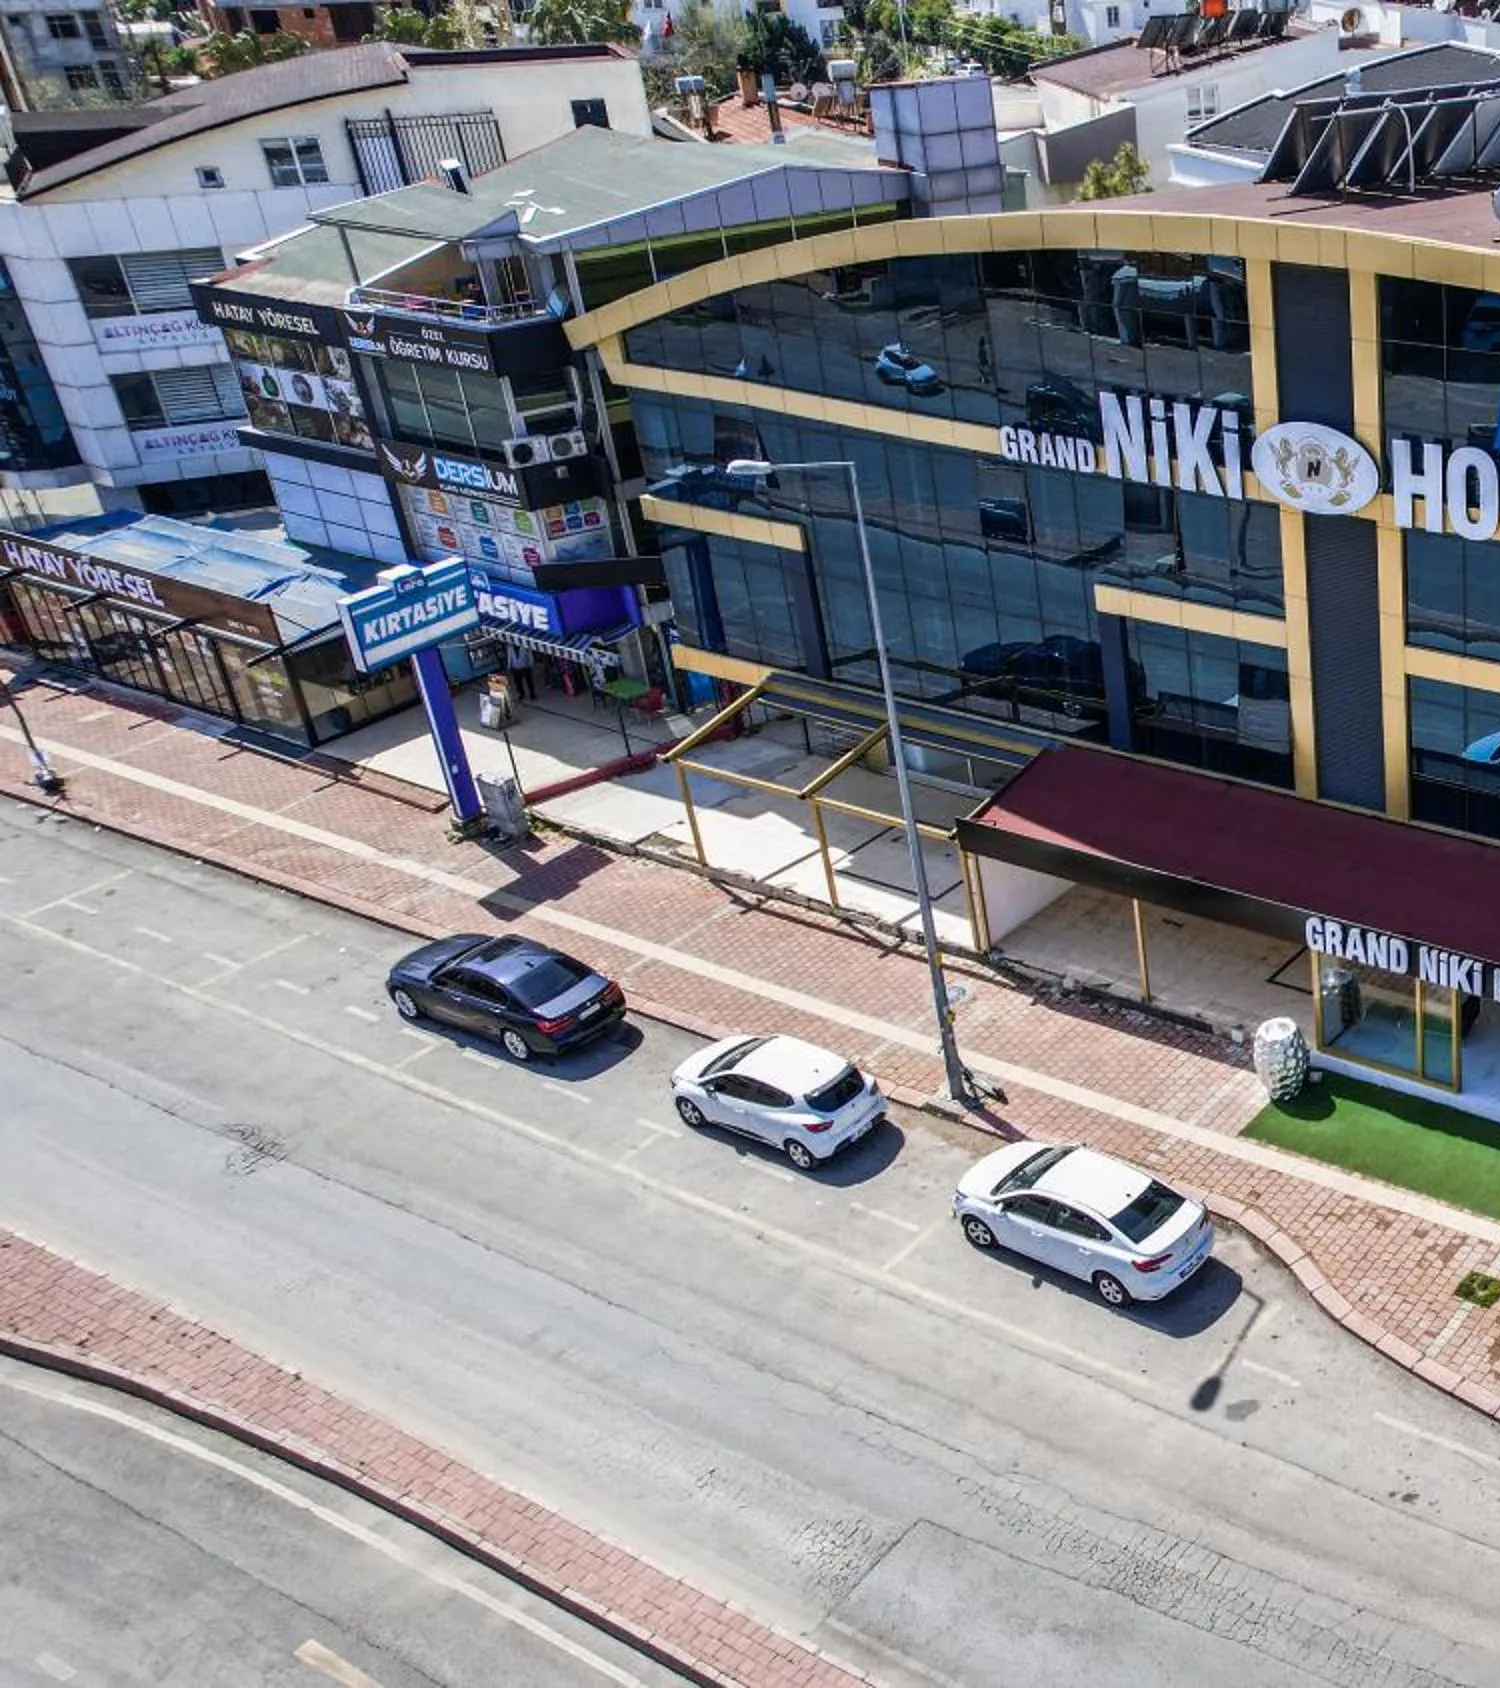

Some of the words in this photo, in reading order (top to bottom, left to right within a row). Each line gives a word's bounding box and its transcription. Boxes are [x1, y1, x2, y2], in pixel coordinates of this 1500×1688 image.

[212, 301, 255, 323] HATAY
[257, 306, 321, 335] YÖRESEL
[447, 350, 489, 371] KURSU
[1000, 424, 1096, 473] GRAND
[1306, 459, 1321, 478] N
[2, 539, 67, 579] HATAY
[68, 554, 165, 608] YÖRESEL
[1305, 917, 1409, 974] GRAND
